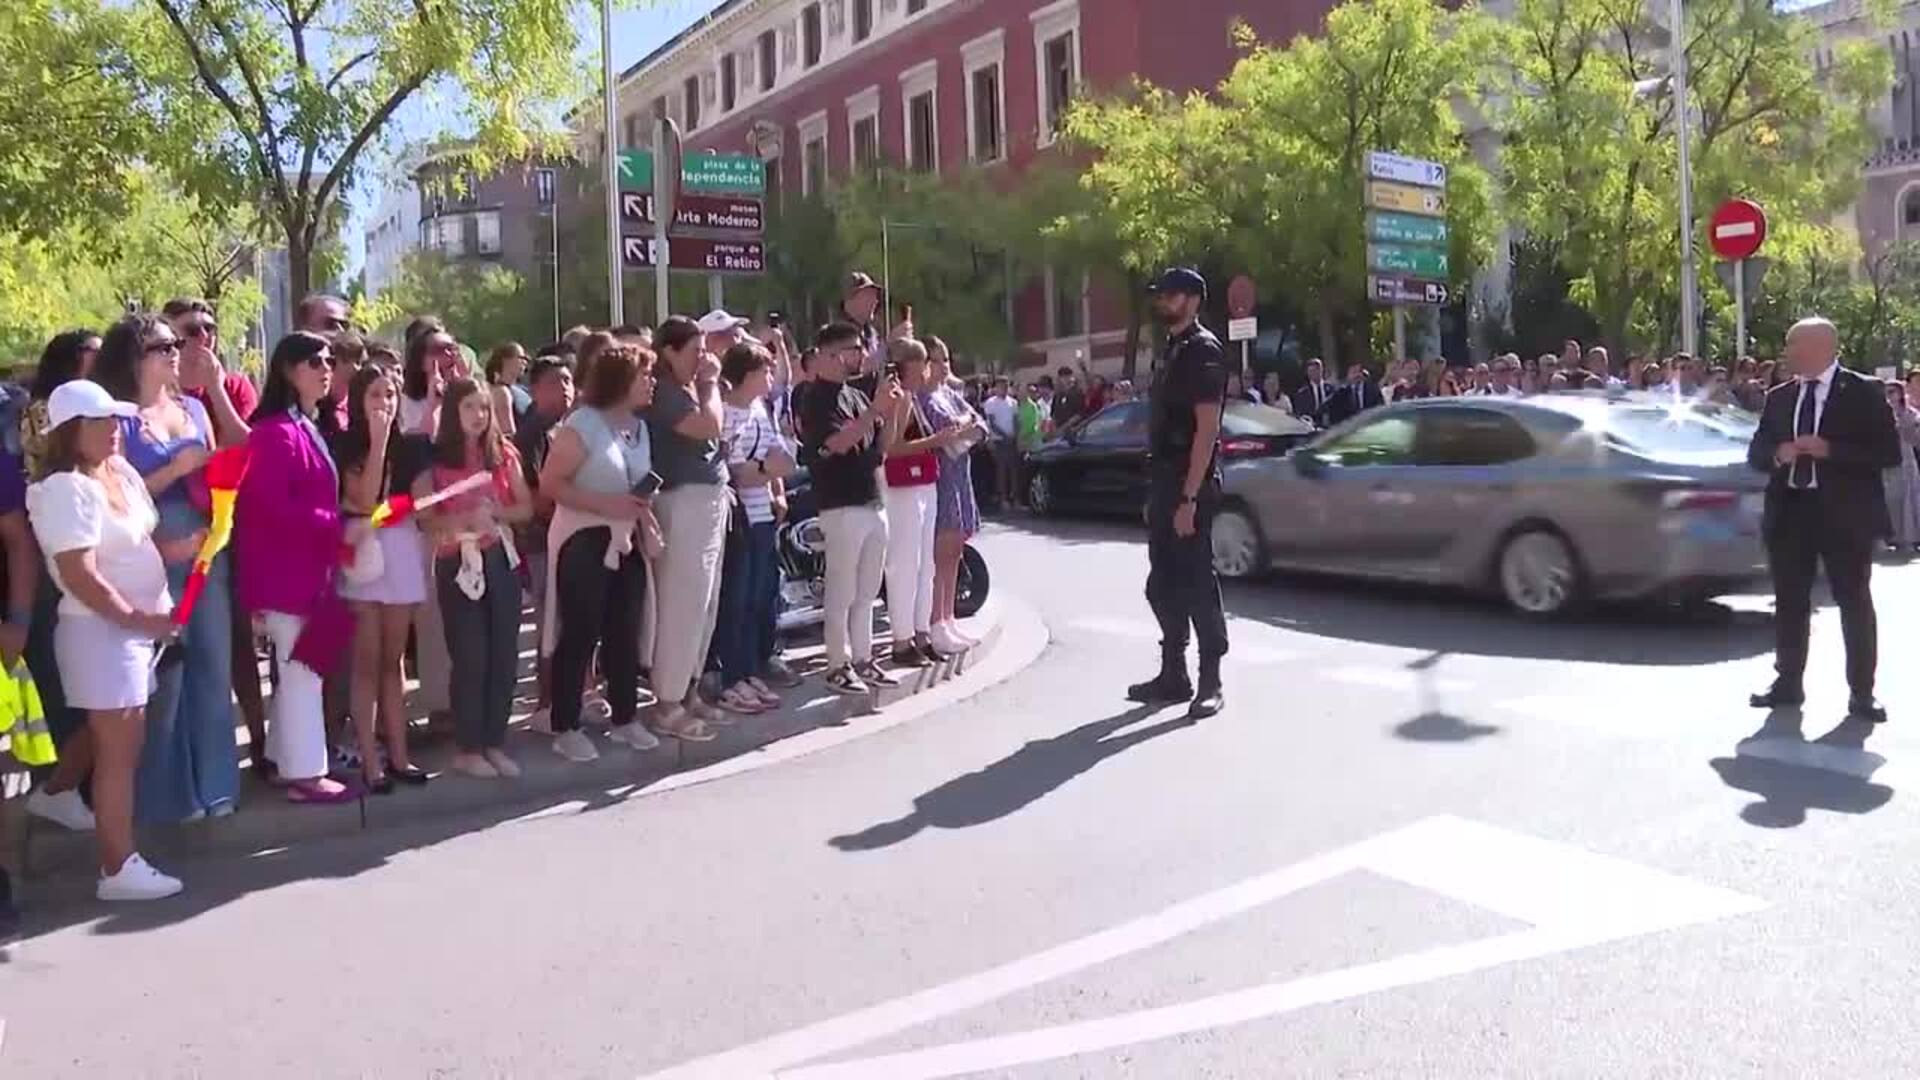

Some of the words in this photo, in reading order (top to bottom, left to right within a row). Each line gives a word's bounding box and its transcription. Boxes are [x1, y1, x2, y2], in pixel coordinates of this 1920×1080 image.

[734, 160, 746, 169] de
[751, 160, 760, 171] la
[730, 205, 758, 213] museo
[707, 213, 759, 227] Moderno
[715, 245, 745, 254] parque
[748, 245, 760, 254] de
[706, 254, 719, 267] El
[725, 256, 760, 269] Retiro
